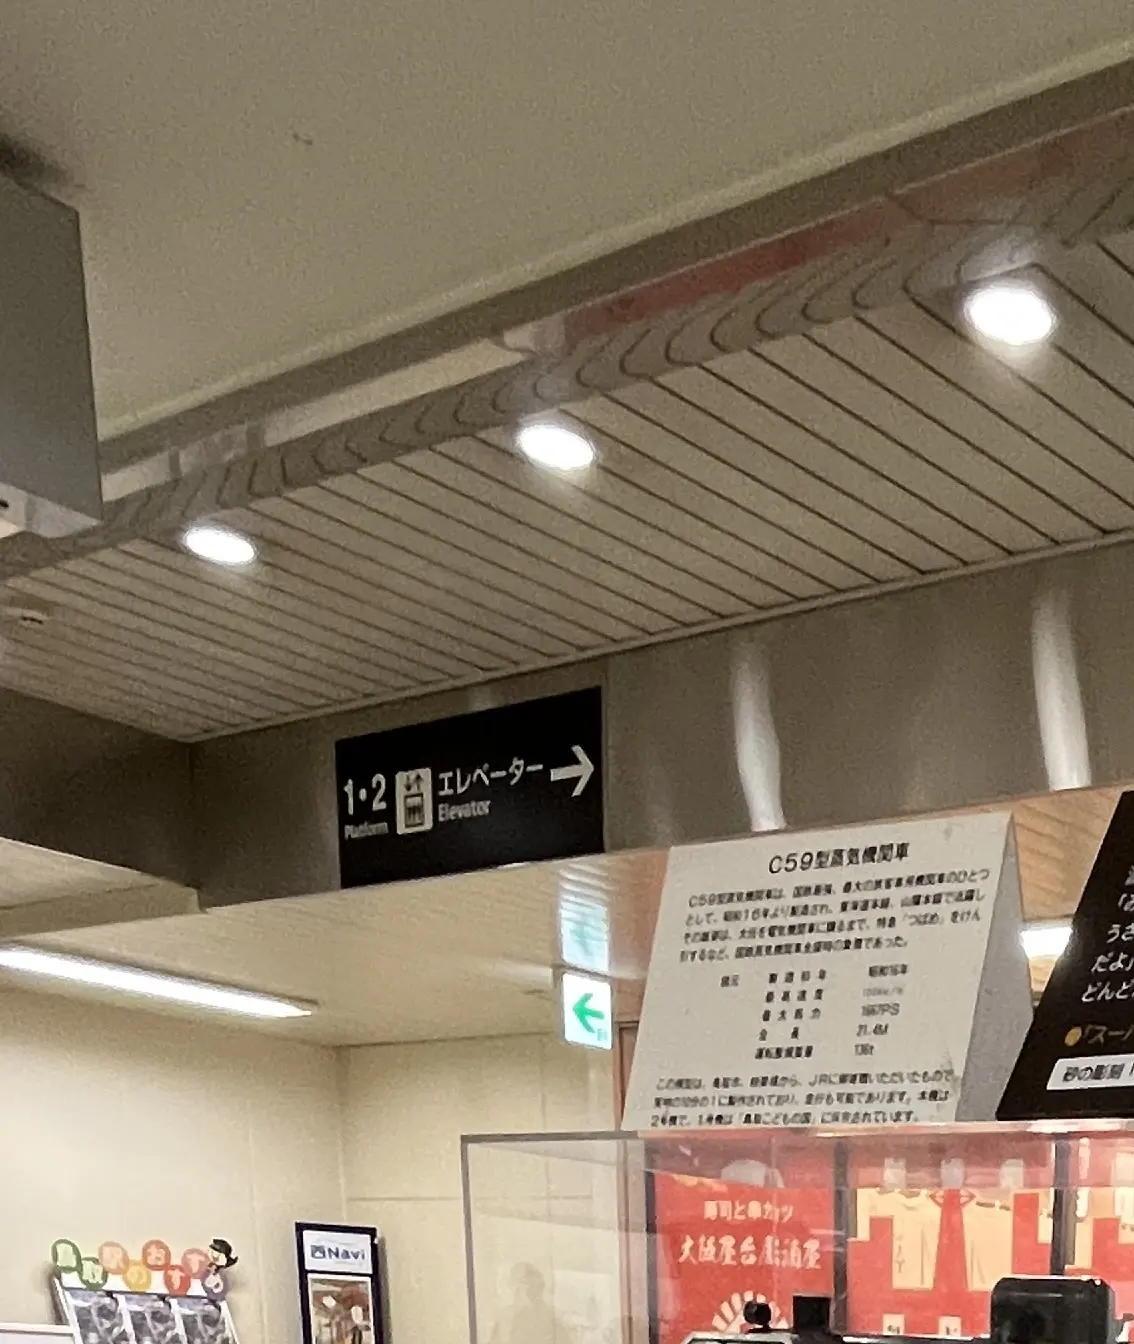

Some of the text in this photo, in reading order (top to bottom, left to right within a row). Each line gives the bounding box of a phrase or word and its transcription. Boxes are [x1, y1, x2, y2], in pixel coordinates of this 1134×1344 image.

[438, 756, 543, 796] エレベーター
[438, 799, 491, 823] Elevator
[344, 821, 389, 840] Platform
[327, 1246, 366, 1261] Navi
